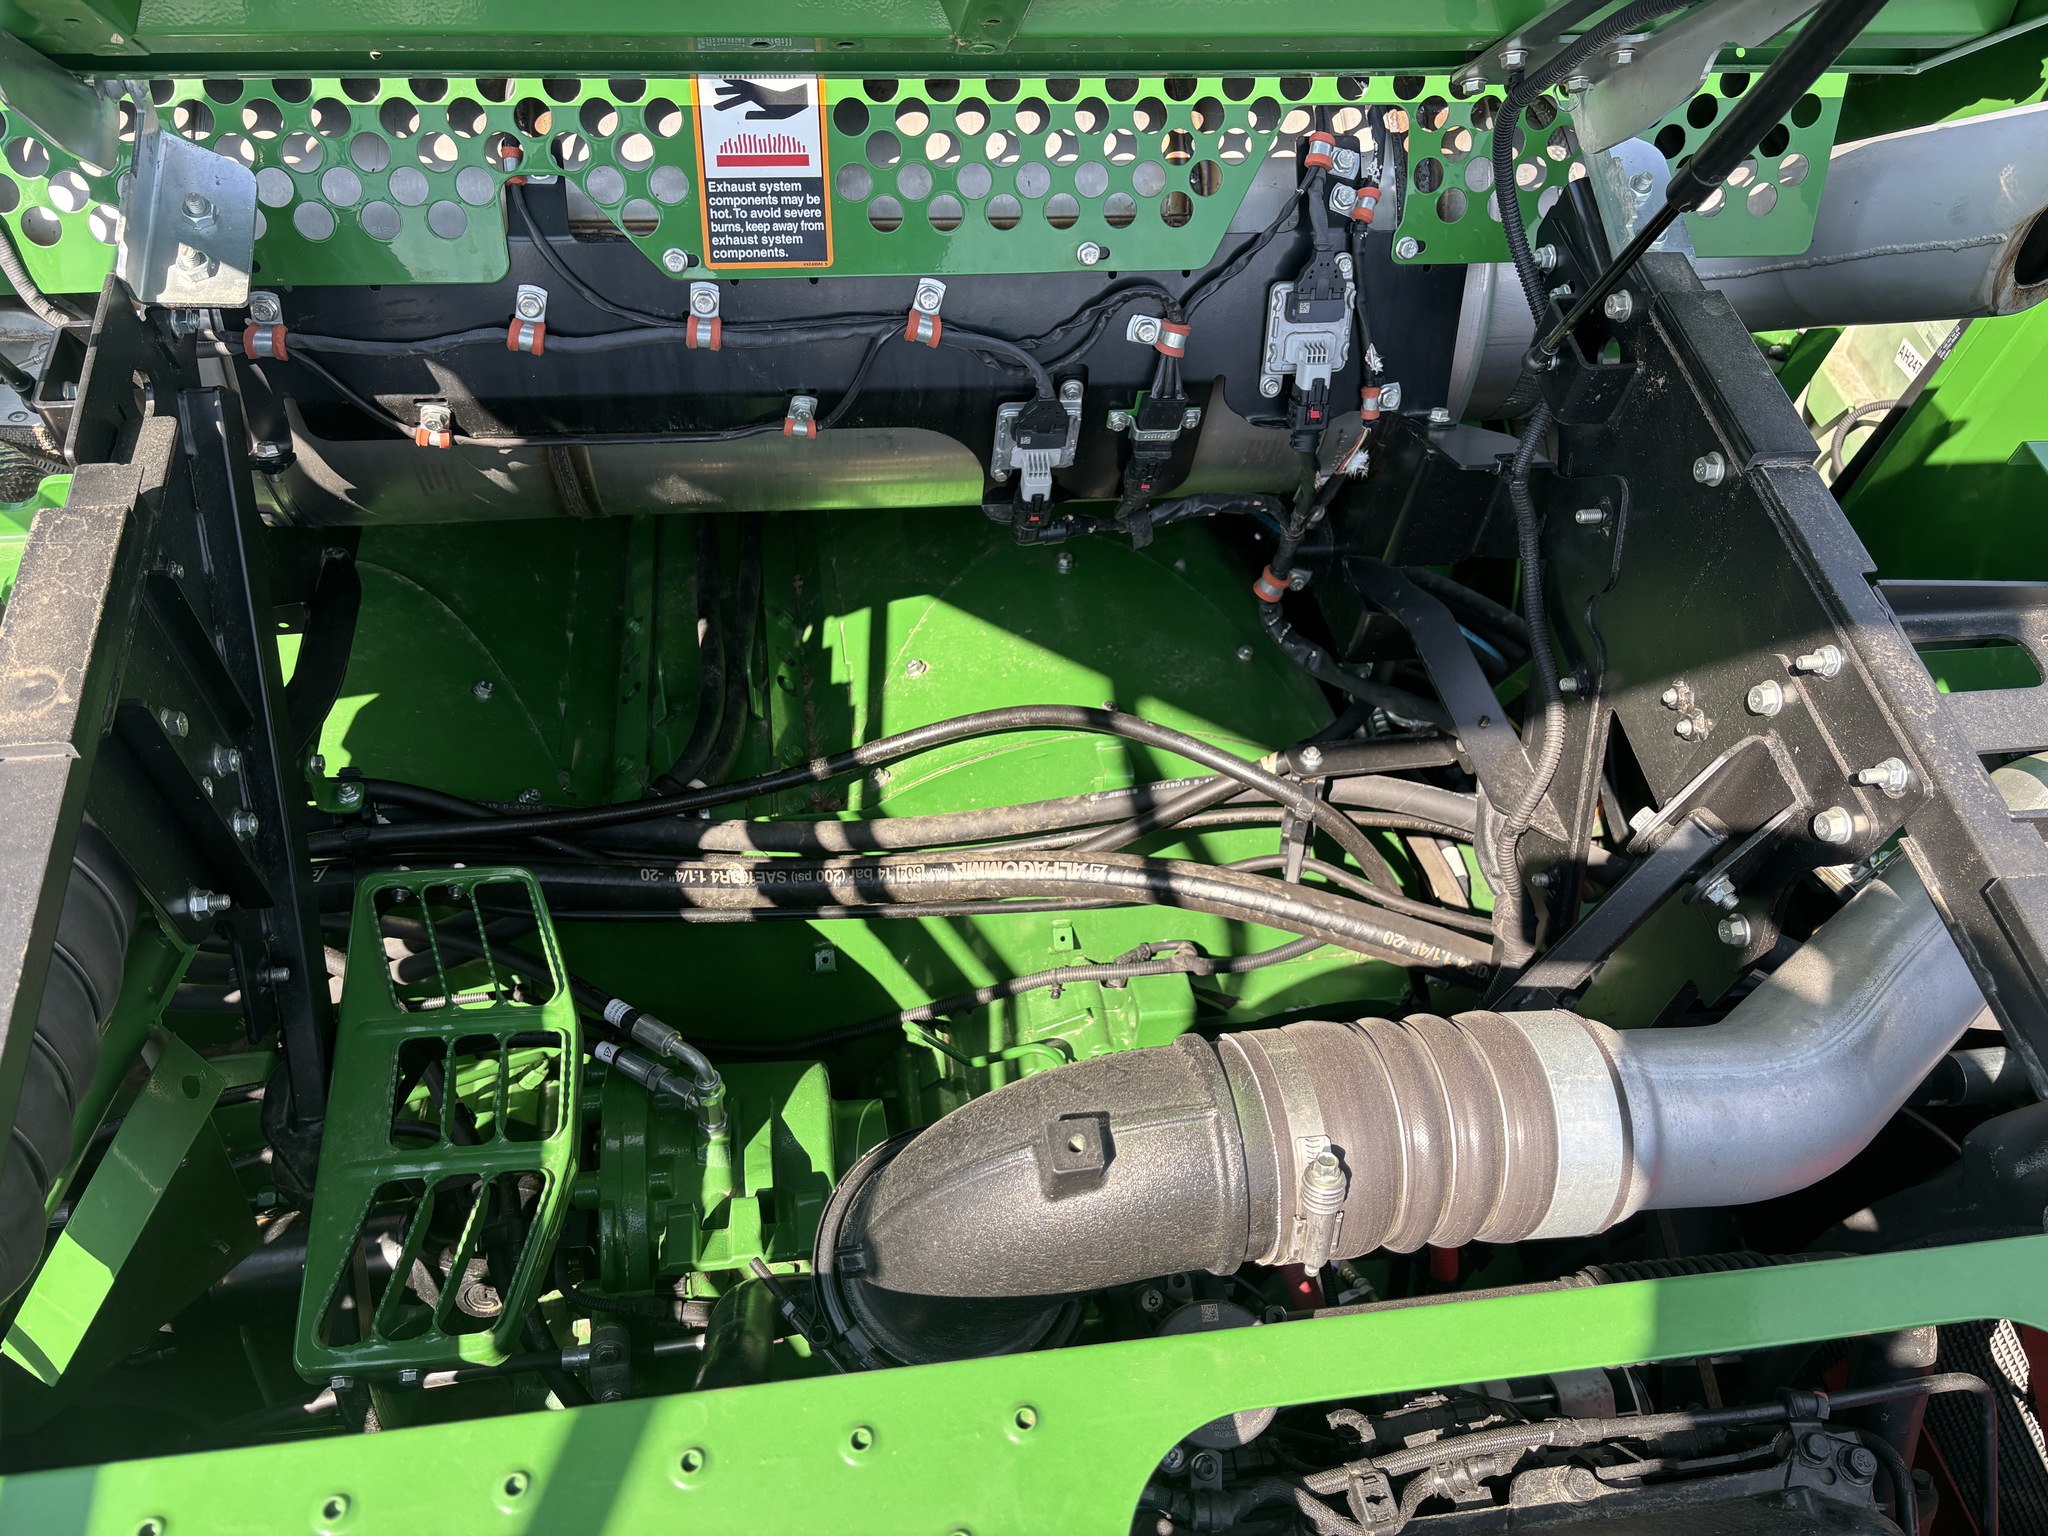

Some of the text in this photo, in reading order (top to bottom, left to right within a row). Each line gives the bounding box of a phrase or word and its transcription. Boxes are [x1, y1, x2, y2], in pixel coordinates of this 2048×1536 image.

[708, 181, 802, 195] Exhaust system
[709, 194, 821, 209] components may be
[710, 208, 822, 219] hot. To avoid severe
[711, 220, 825, 235] burns, keep away from
[712, 234, 804, 248] exhaust system
[713, 247, 789, 261] components.
[639, 867, 664, 882] -20
[791, 871, 812, 883] psi)
[816, 869, 846, 884] (200
[849, 868, 873, 881] bar
[952, 861, 1089, 881] ALFAGOMMA
